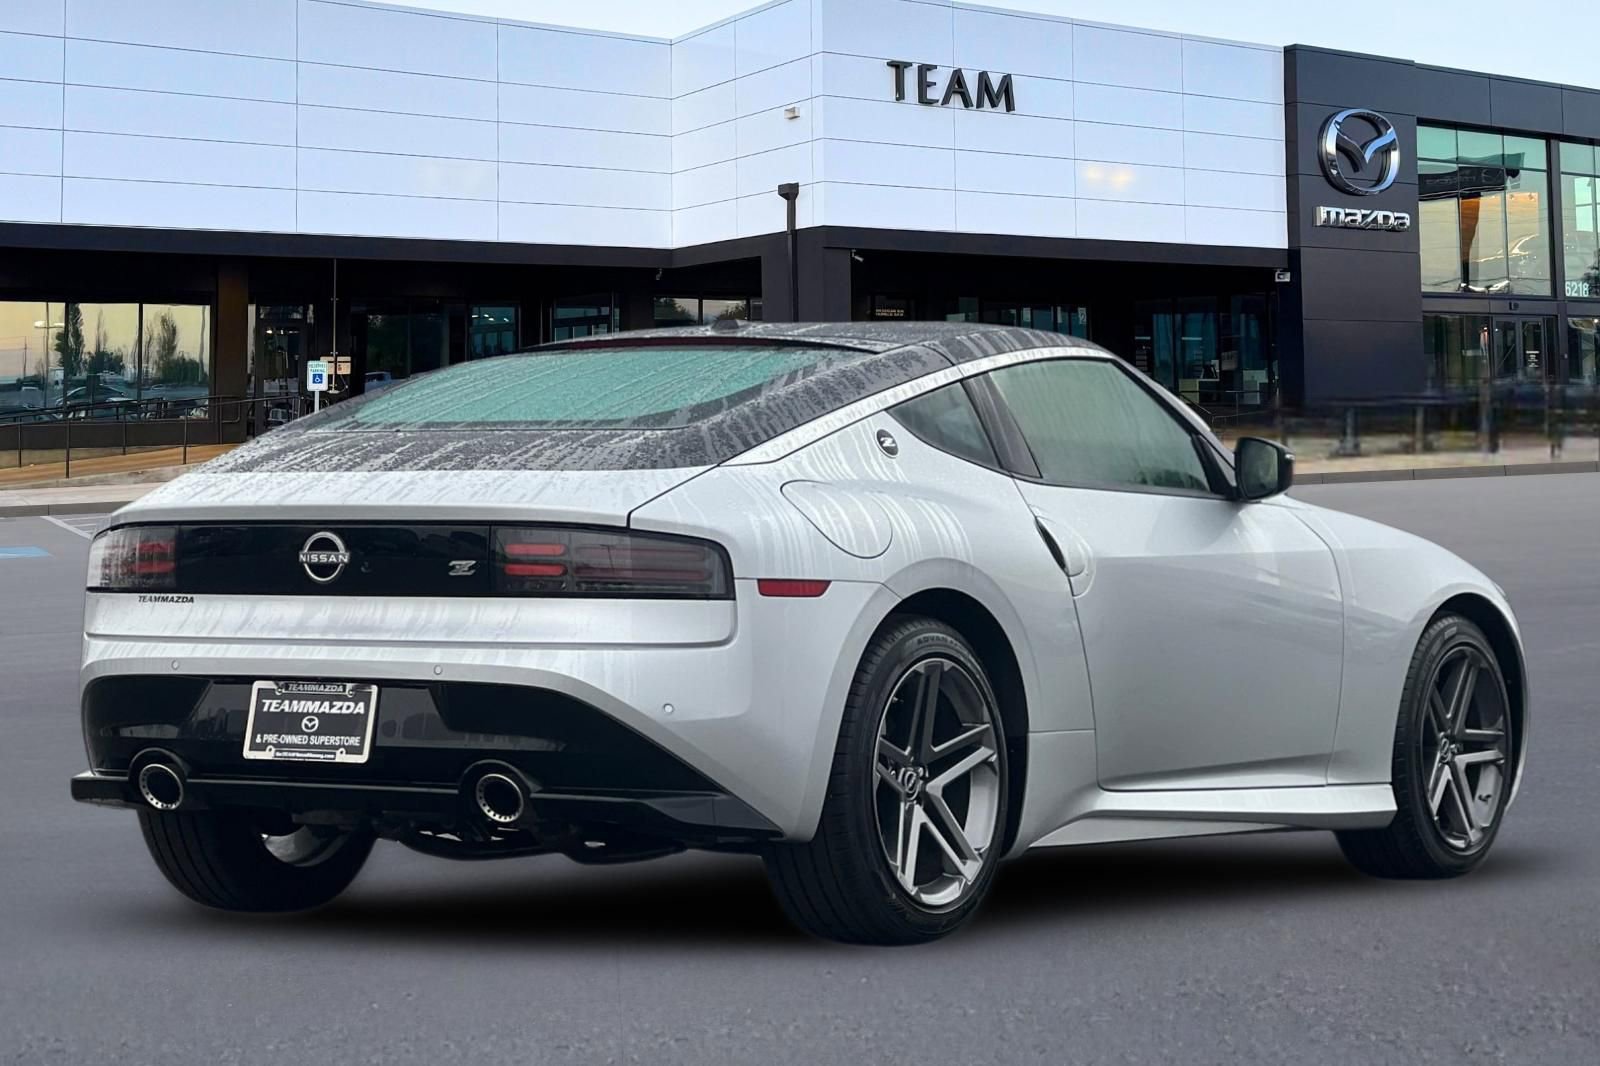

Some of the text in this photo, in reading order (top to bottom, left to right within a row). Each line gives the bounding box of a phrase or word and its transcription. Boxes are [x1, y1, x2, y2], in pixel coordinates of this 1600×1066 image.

[887, 60, 1015, 113] TEAM
[1314, 206, 1411, 231] mazda
[1565, 281, 1590, 297] 6218
[299, 553, 349, 563] NISSAN
[448, 560, 477, 576] Z
[138, 595, 195, 604] TEAMMAZDA
[288, 683, 344, 692] TEAMMAZDA
[261, 699, 365, 714] TEAMMAZDA
[256, 734, 361, 746] & PRE-OWNED SUPERSTORE
